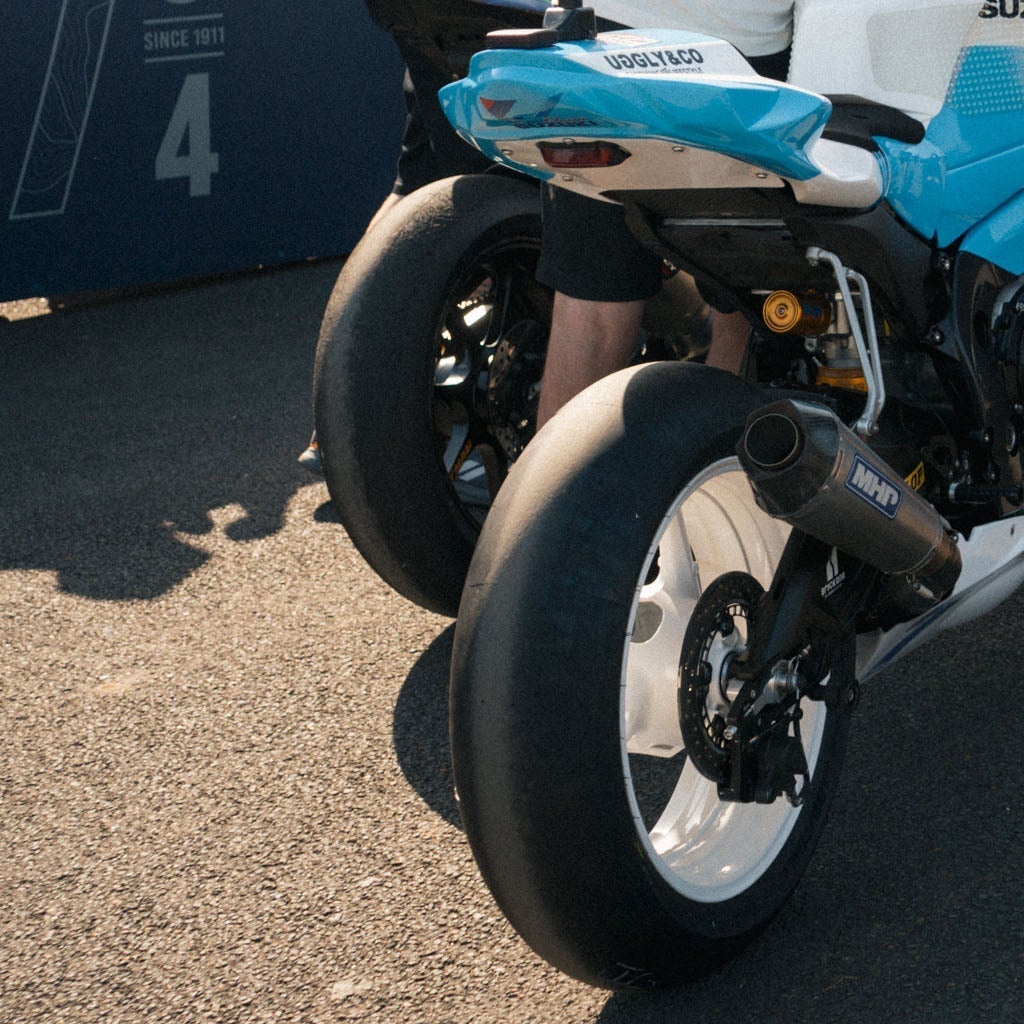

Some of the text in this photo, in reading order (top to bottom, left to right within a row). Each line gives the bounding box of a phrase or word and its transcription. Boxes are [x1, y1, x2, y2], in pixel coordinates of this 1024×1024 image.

[144, 26, 225, 51] SINCE 1911
[604, 47, 704, 71] UGGLY&CO
[155, 73, 219, 197] 4
[851, 463, 899, 507] MHP
